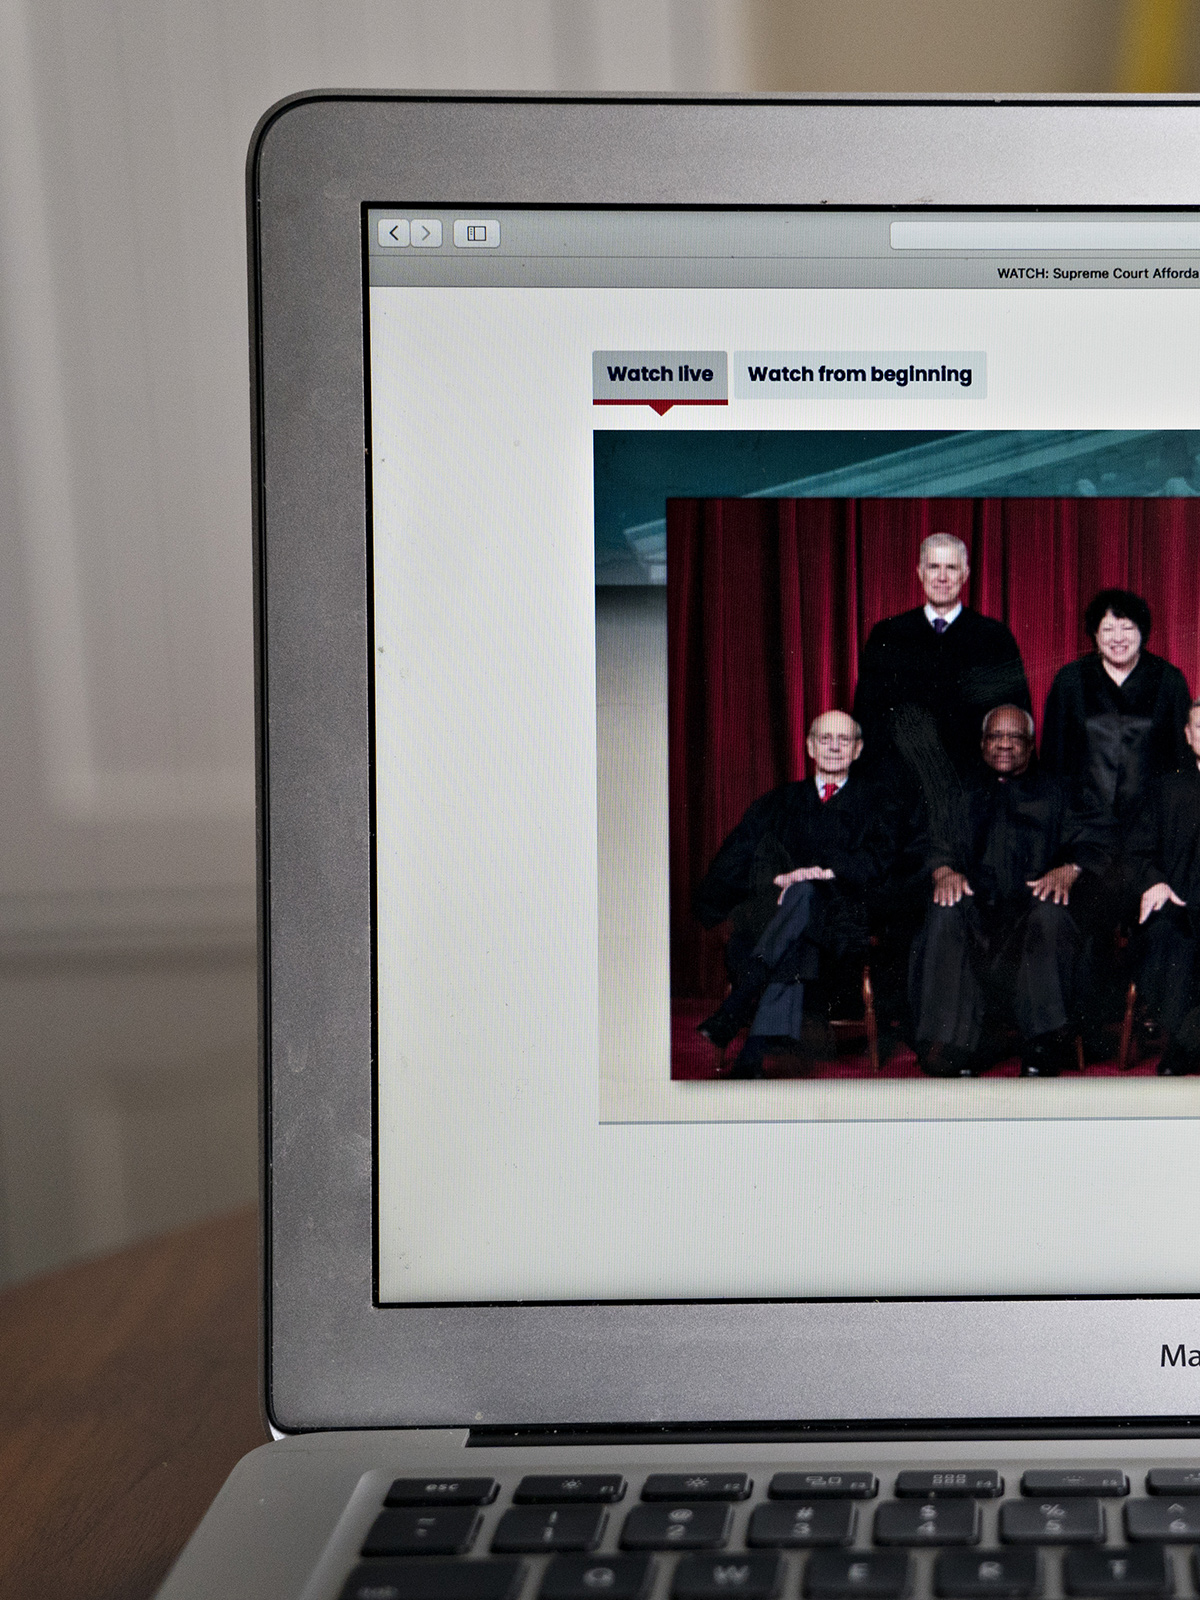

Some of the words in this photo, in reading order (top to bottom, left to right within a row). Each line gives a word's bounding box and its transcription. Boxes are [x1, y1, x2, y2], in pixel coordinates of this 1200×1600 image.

[997, 267, 1049, 279] WATCH:
[1053, 267, 1110, 281] Supreme
[1112, 267, 1149, 279] Court
[607, 365, 674, 382] Watch
[678, 364, 714, 382] live
[747, 366, 814, 382] Watch
[818, 364, 868, 382] from
[871, 364, 973, 387] beginning
[917, 1520, 936, 1535] 4
[1168, 1518, 1187, 1533] 6
